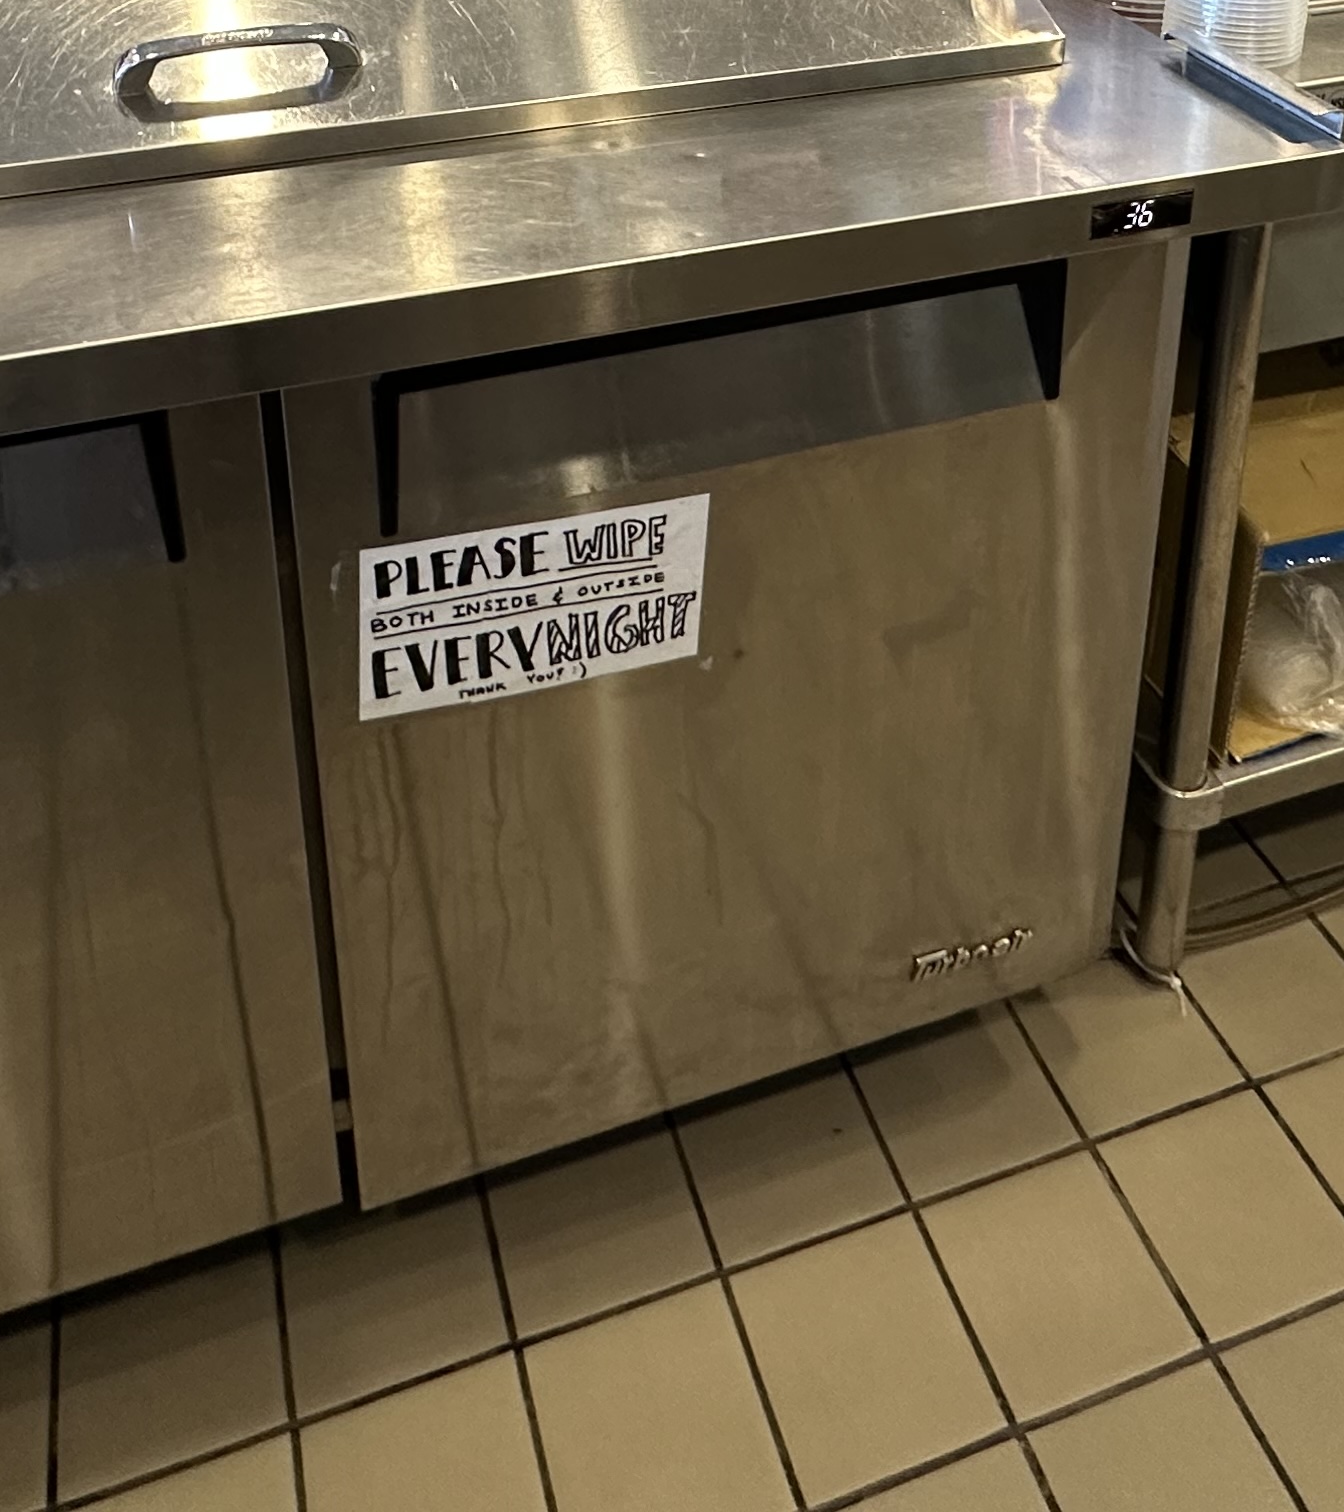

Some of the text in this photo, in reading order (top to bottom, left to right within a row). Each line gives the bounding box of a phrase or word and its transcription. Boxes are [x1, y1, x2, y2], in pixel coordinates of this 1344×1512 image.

[1123, 199, 1155, 230] 36
[374, 514, 668, 600] PLEASE WIPE
[371, 610, 435, 634] BOTH
[452, 593, 538, 619] INSIDE
[577, 571, 666, 597] OUTSIDE
[370, 590, 698, 700] EVERYNIGHT
[458, 682, 508, 700] THANK
